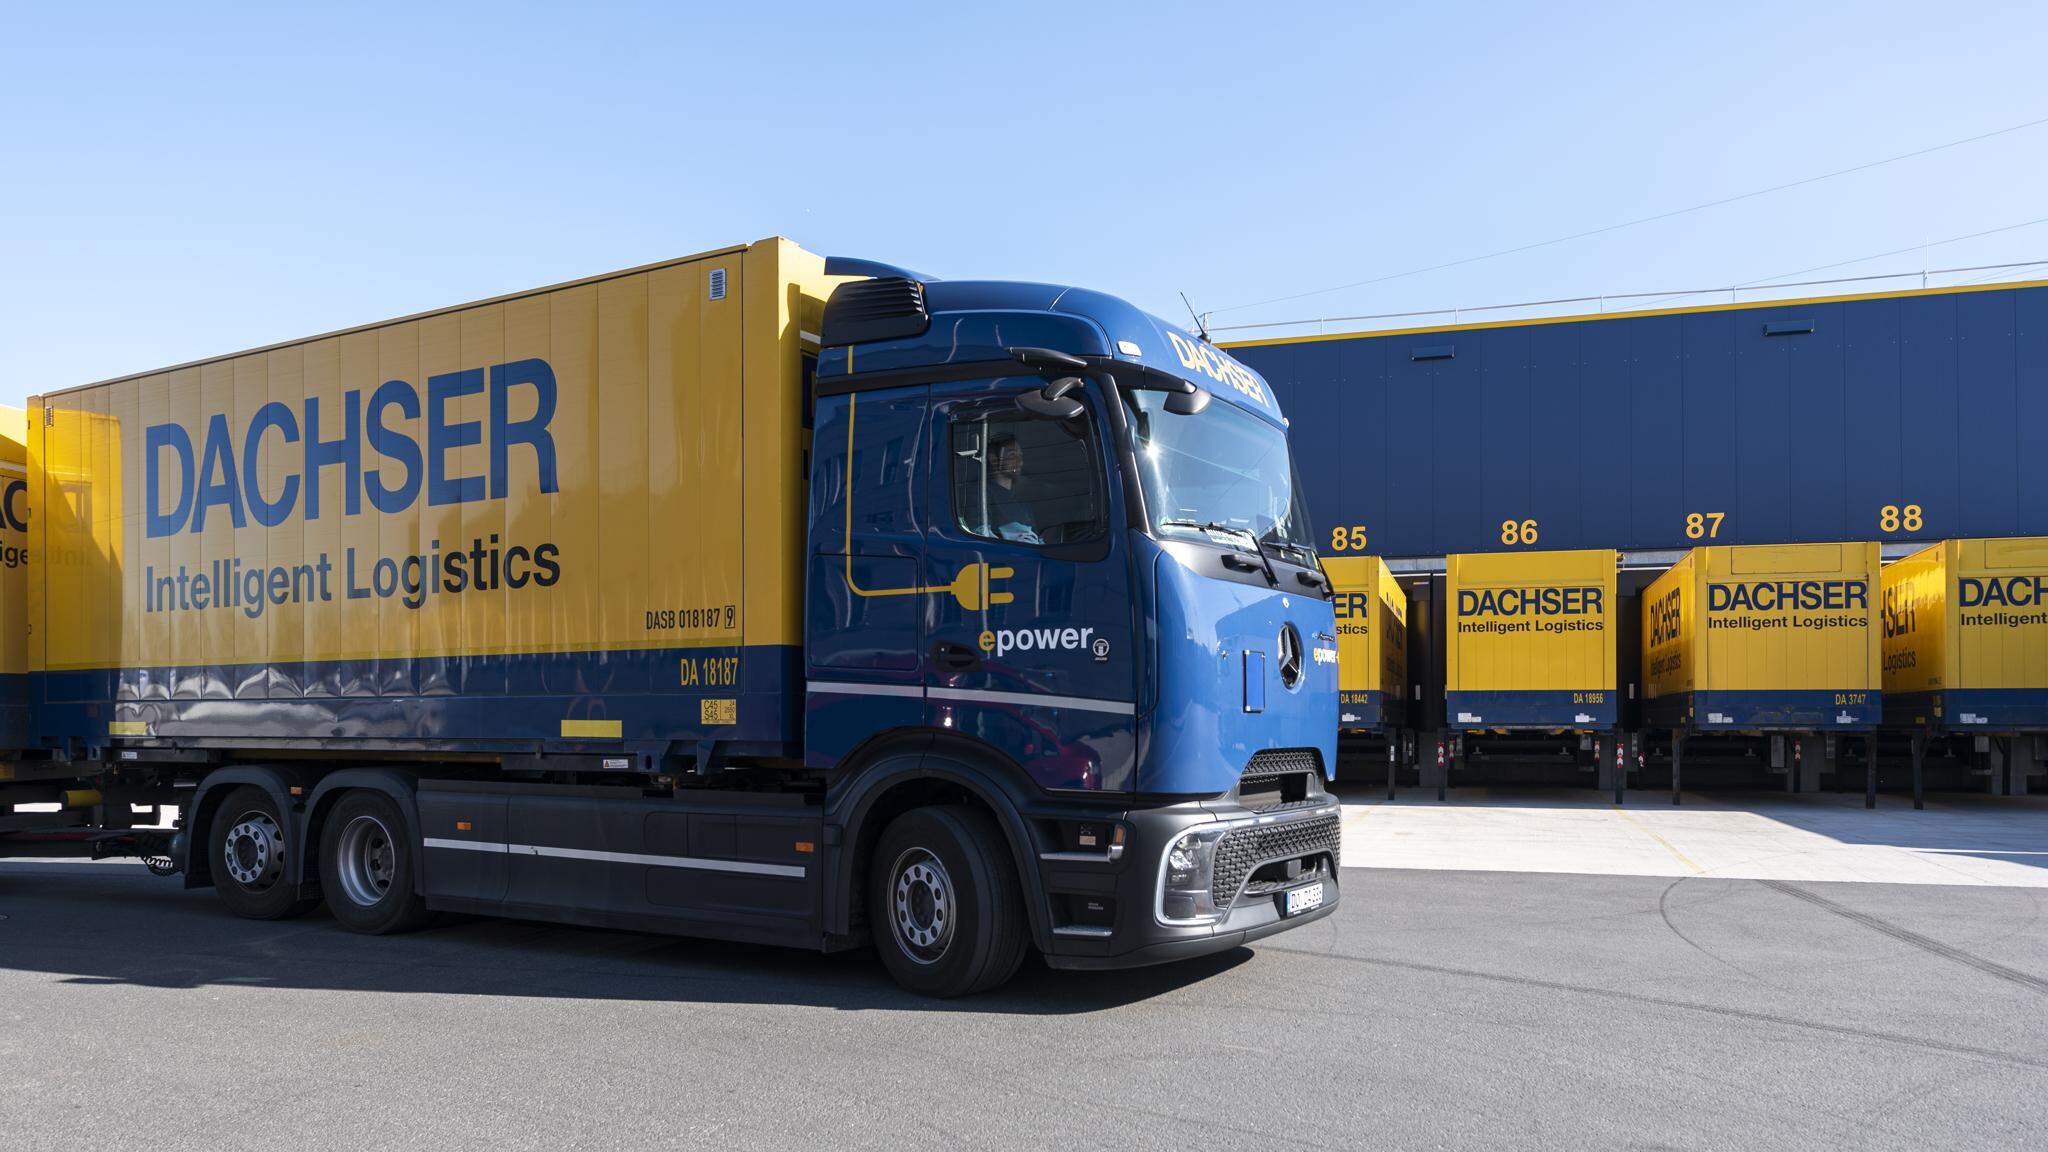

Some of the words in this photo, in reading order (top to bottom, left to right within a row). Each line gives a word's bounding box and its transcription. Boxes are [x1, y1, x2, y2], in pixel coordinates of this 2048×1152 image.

[1167, 331, 1269, 408] DACHSER
[146, 357, 559, 539] DACHSER
[1685, 512, 1725, 539] 87
[1880, 504, 1923, 532] 88
[1331, 525, 1367, 551] 85
[1500, 519, 1538, 545] 86
[146, 553, 332, 619] Intelligent
[346, 534, 560, 610] Logistics
[1457, 587, 1604, 616] DACHSER
[1708, 581, 1868, 611] DACHSER
[646, 610, 676, 630] DASB
[679, 608, 720, 629] 018187
[726, 607, 734, 628] 9
[1457, 621, 1531, 635] Intelligent
[1535, 619, 1604, 633] Logistics
[1650, 587, 1681, 649] DACHSER
[1708, 616, 1788, 631] Intelligent
[1793, 614, 1868, 630] Logistics
[1961, 612, 2048, 628] Intelligent
[978, 627, 1093, 657] epower
[680, 658, 699, 686] DA
[703, 657, 738, 686] 18187
[1883, 648, 1916, 674] Logistics
[1340, 693, 1350, 704] DA
[1574, 692, 1584, 704] DA
[1835, 694, 1847, 705] DA
[1849, 694, 1867, 704] 3747
